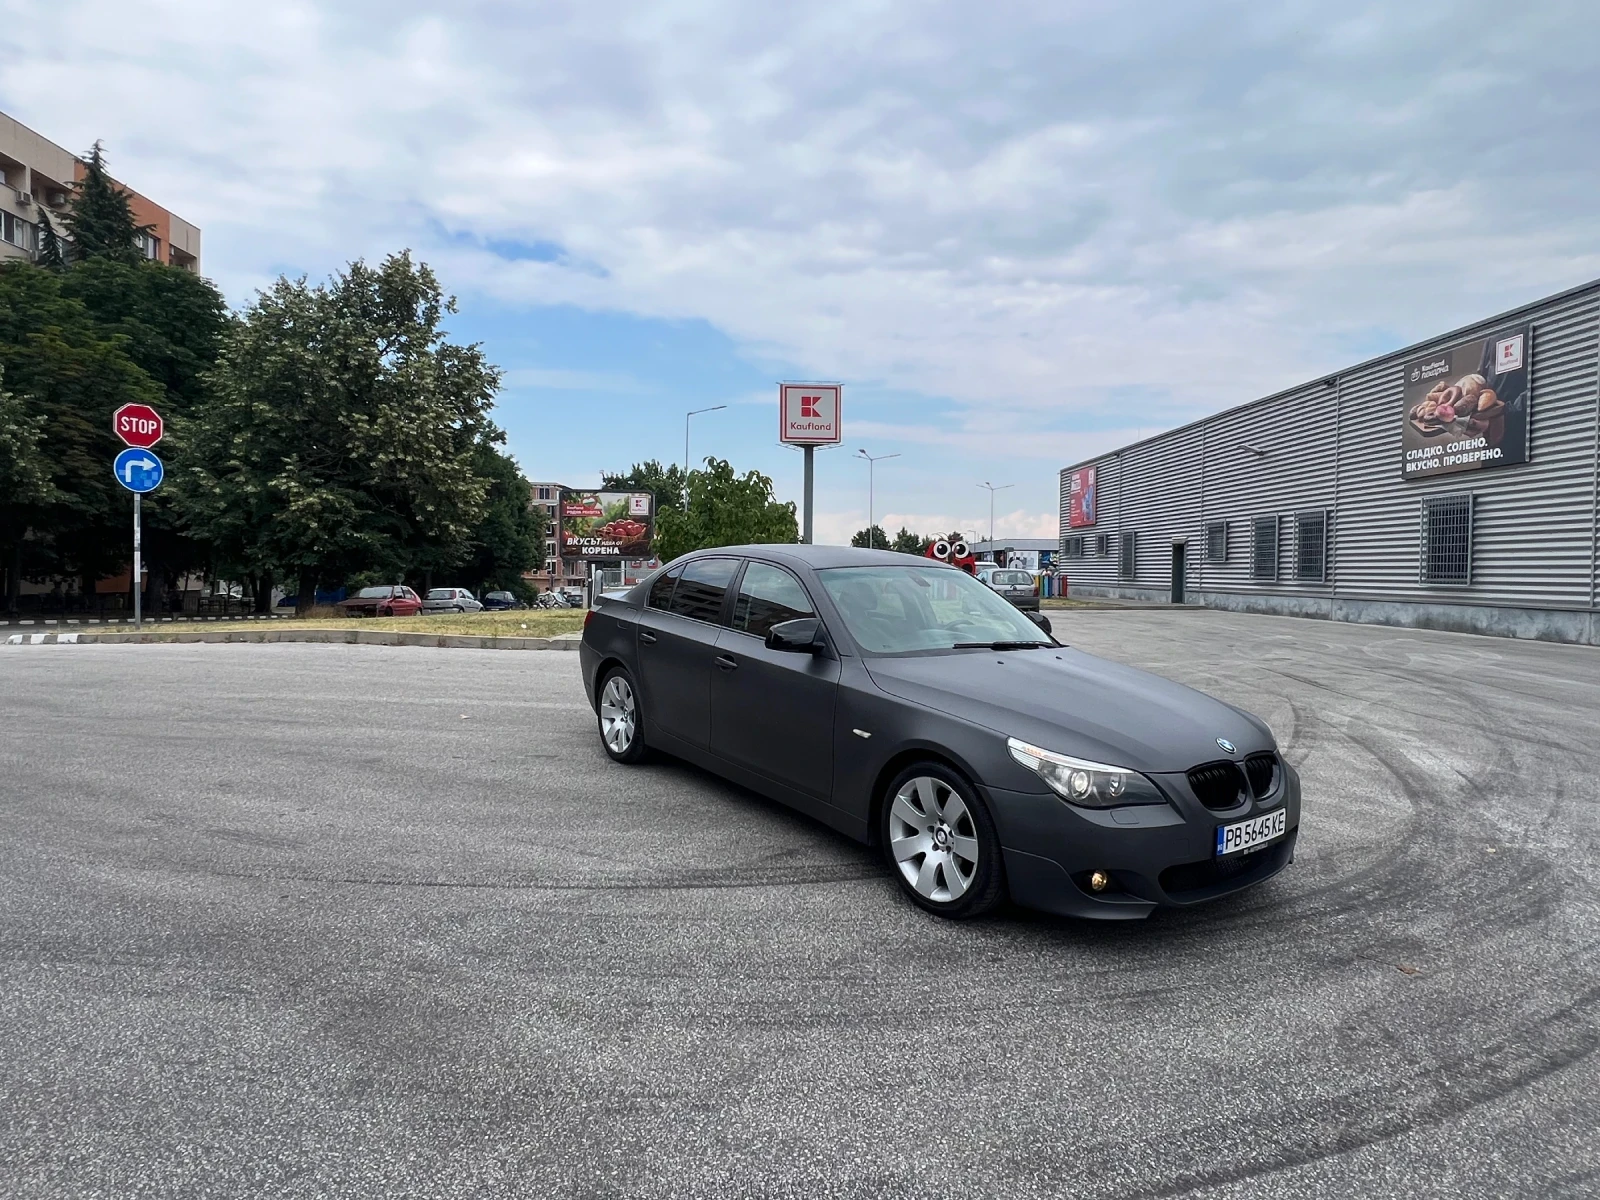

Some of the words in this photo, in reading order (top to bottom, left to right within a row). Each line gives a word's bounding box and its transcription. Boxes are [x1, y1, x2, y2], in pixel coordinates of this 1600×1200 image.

[120, 416, 158, 435] STOP
[790, 421, 832, 431] Kaufland
[1406, 445, 1445, 461] СЛАДКО.
[1446, 437, 1488, 453] СОЛЕНО.
[1406, 458, 1442, 473] ВКУСНО.
[1443, 447, 1504, 466] ПРОВЕРЕНО.
[566, 537, 602, 546] ВКУСЪТ
[581, 547, 620, 555] КОРЕНА
[1225, 826, 1242, 850] PB
[1244, 818, 1271, 844] 5645
[1271, 811, 1285, 835] KE
